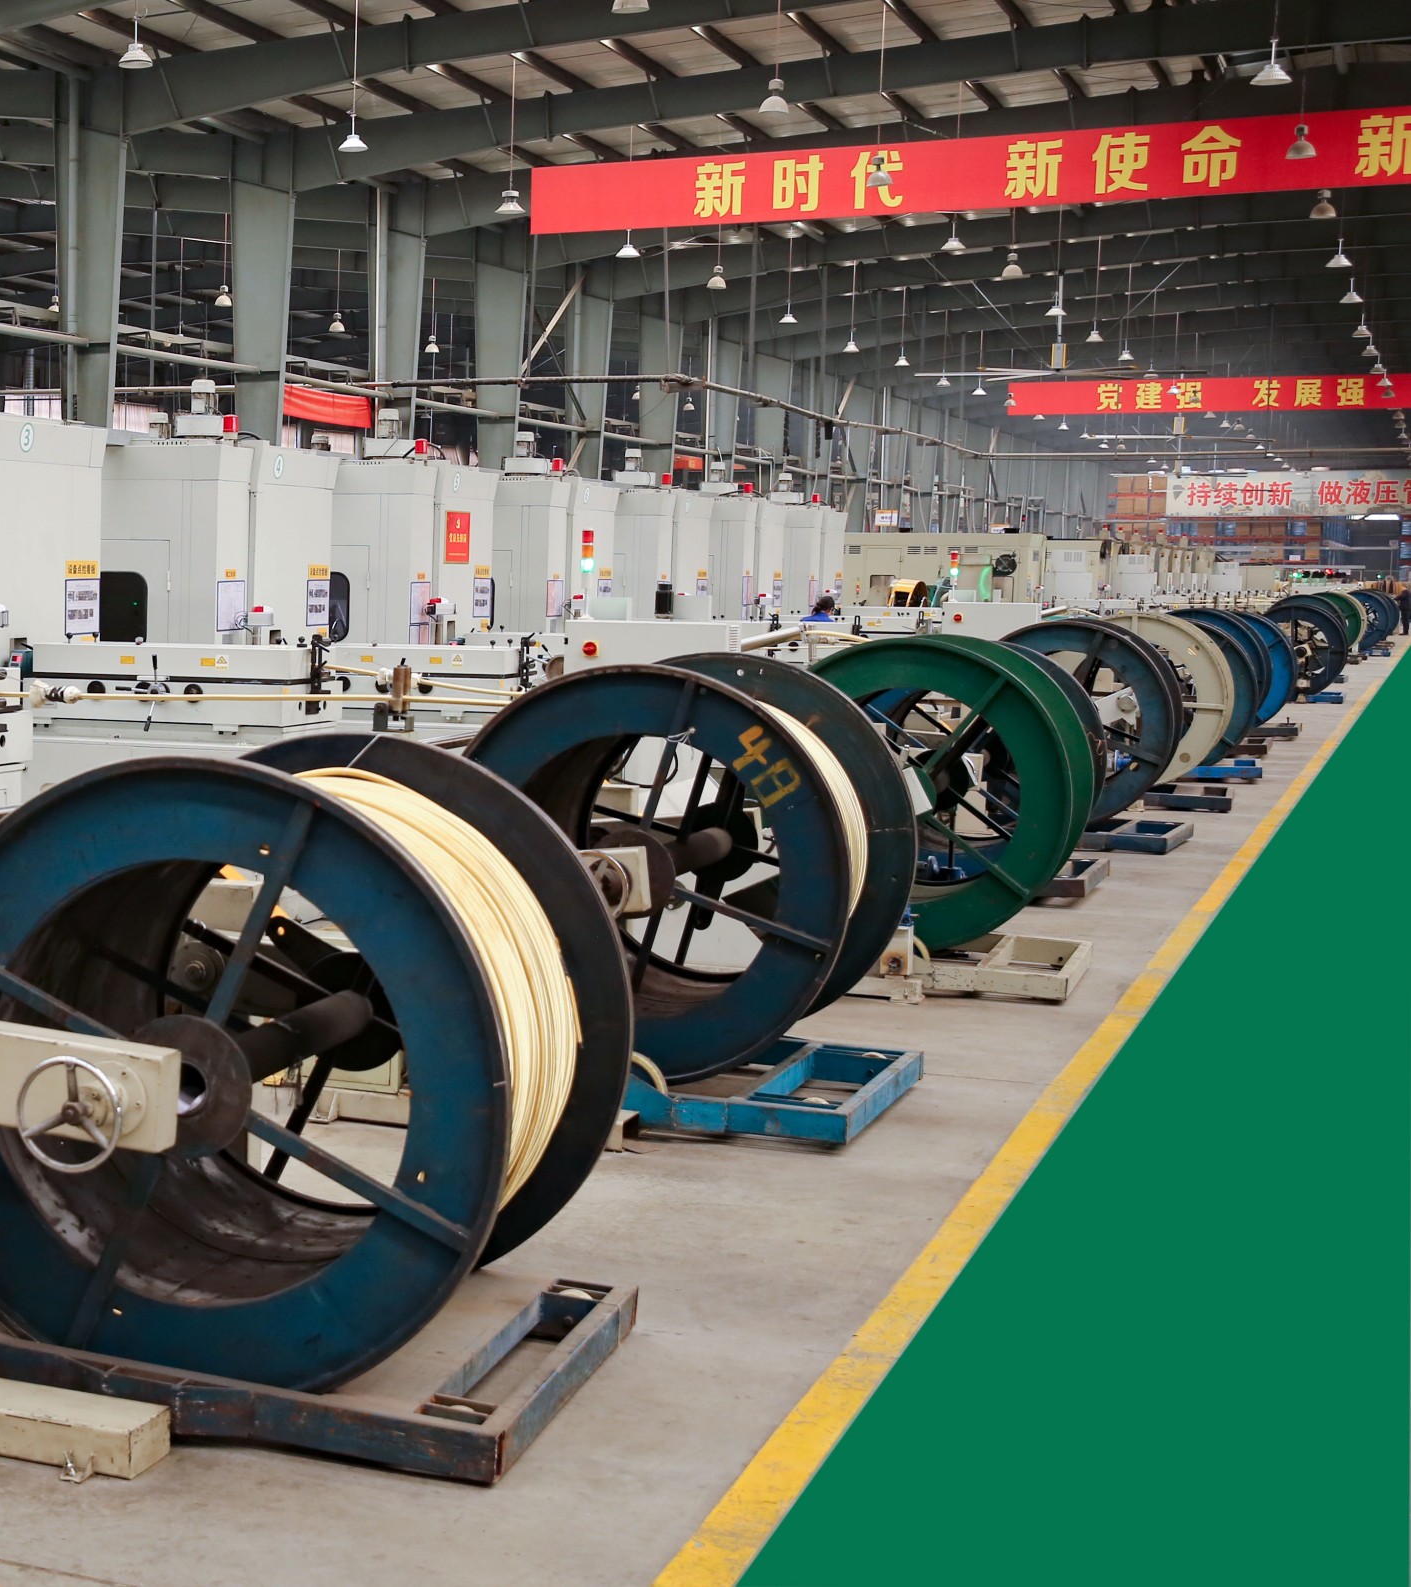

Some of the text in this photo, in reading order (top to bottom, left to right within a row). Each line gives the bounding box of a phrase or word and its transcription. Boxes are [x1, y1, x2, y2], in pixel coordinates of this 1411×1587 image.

[693, 114, 1411, 218] 新时代 新使命 新
[1096, 378, 1365, 411] 党建强 发展强
[1186, 480, 1293, 507] 持续创新
